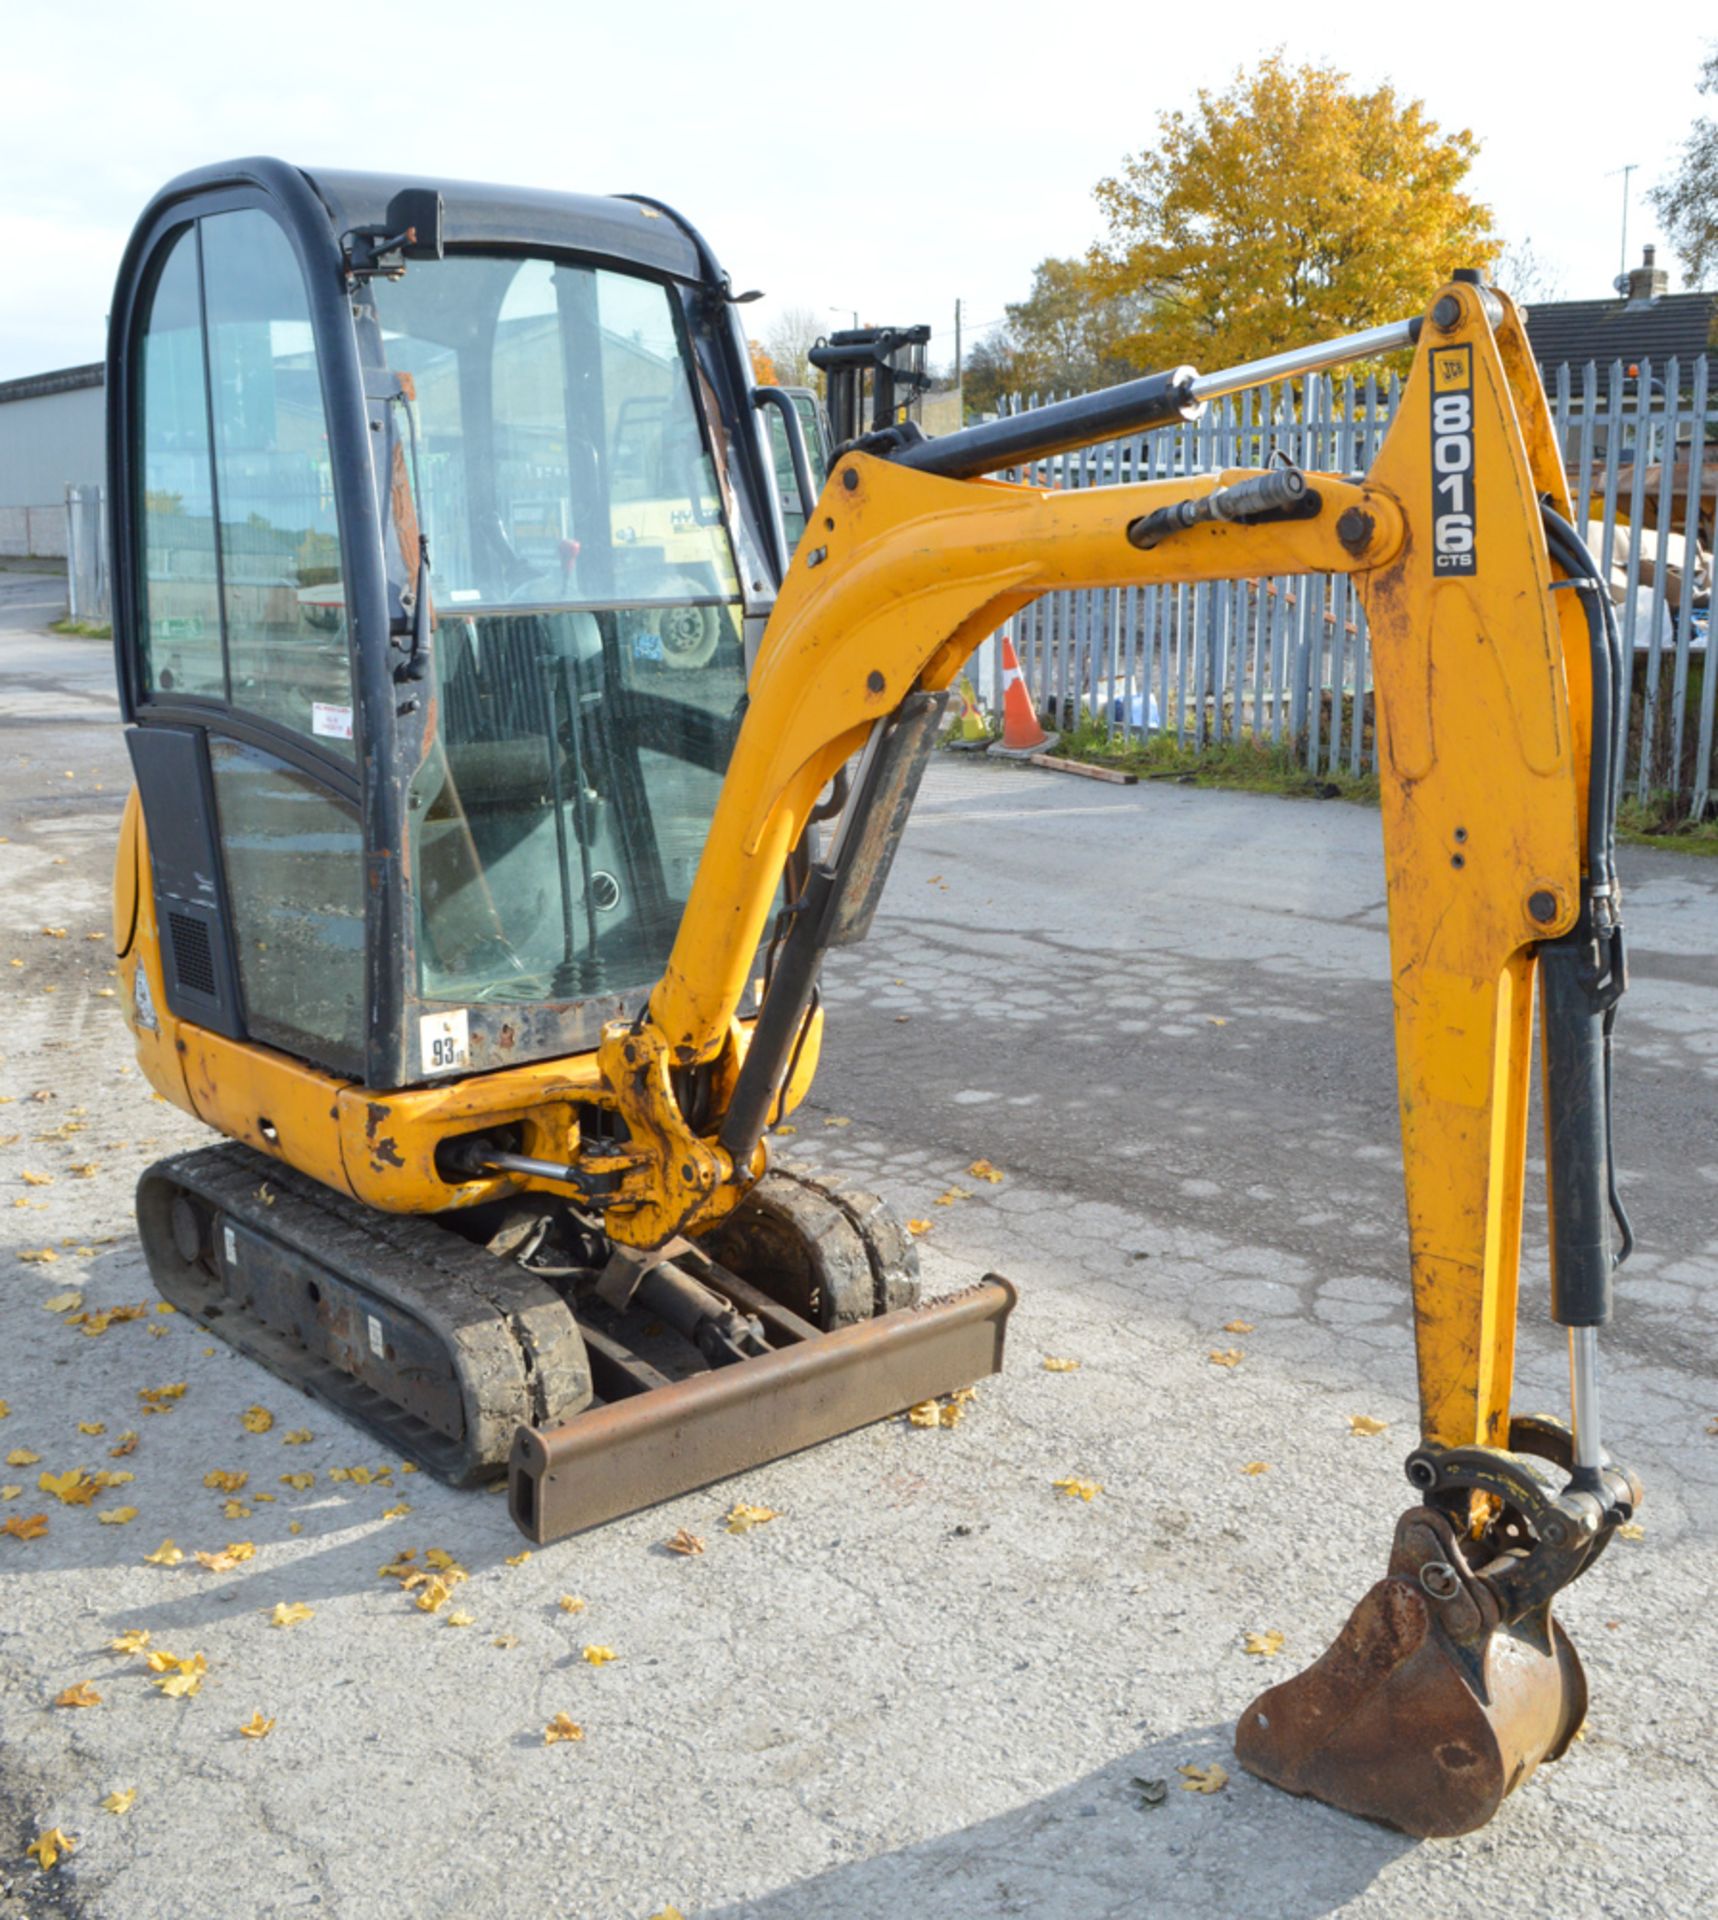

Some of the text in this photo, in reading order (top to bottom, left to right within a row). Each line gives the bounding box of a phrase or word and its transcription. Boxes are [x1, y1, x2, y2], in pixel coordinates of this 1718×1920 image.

[1433, 395, 1473, 553] 8016
[1436, 554, 1473, 567] CTS
[433, 1037, 454, 1066] 93
